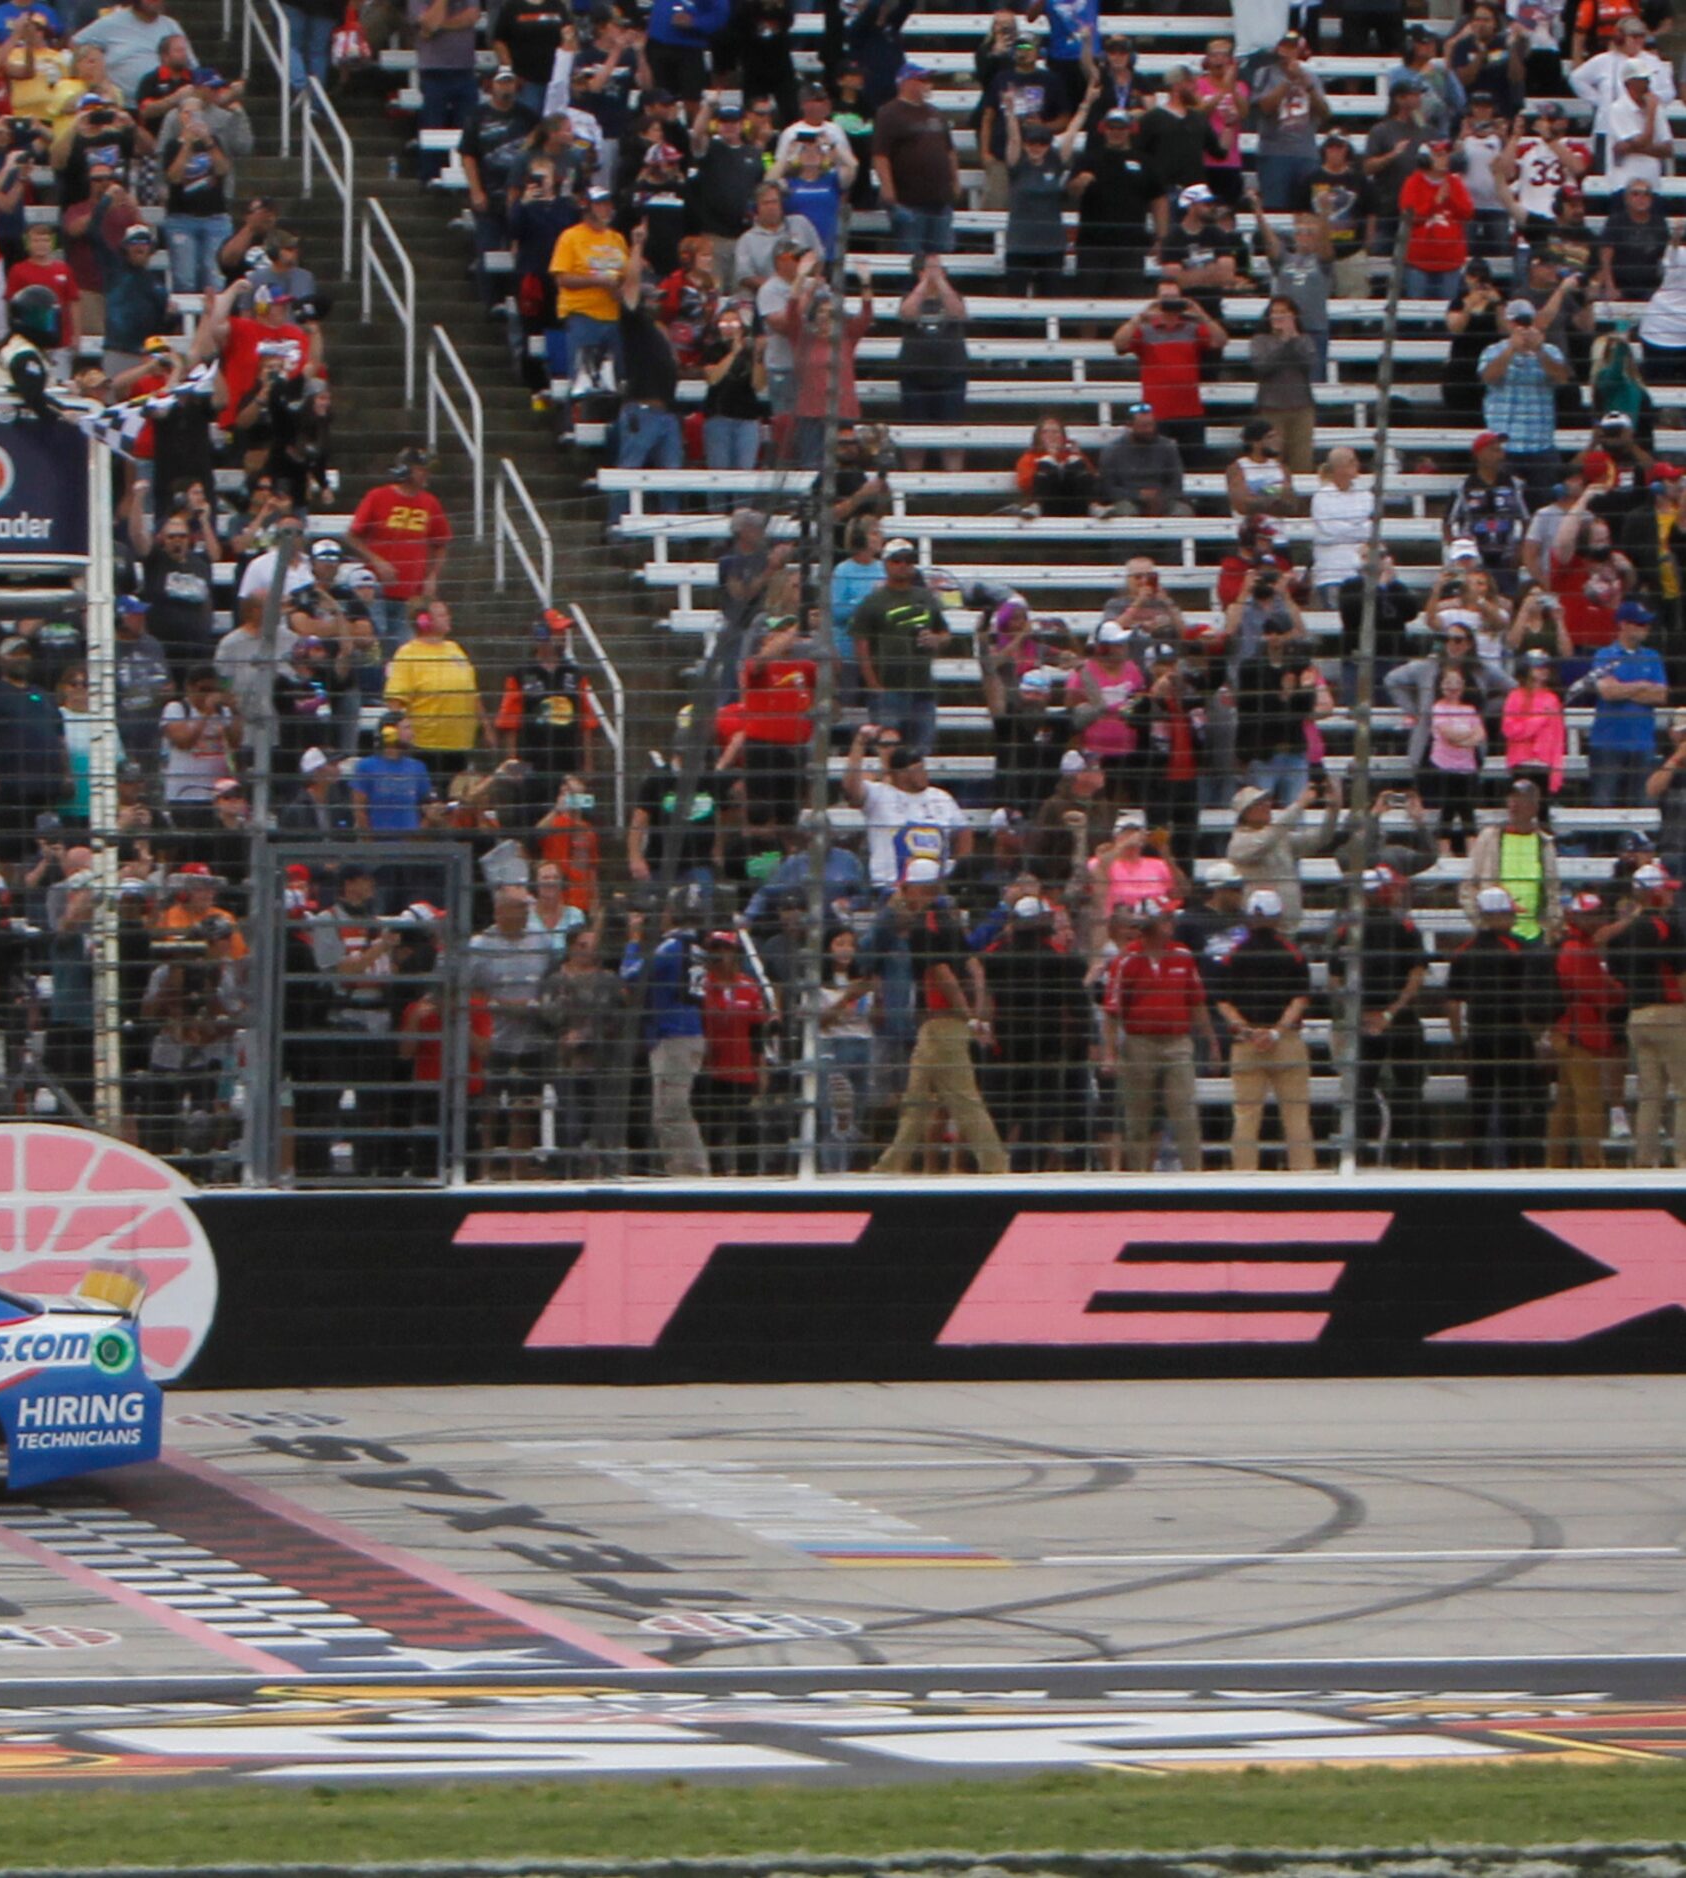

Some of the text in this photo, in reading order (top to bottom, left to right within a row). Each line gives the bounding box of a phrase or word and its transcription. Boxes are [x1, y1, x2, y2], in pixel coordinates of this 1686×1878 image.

[1530, 159, 1564, 187] 33
[386, 506, 430, 532] 22
[17, 1392, 145, 1428] HIRING
[16, 1428, 142, 1451] TECHNICIANS
[72, 1710, 1520, 1776] 25
